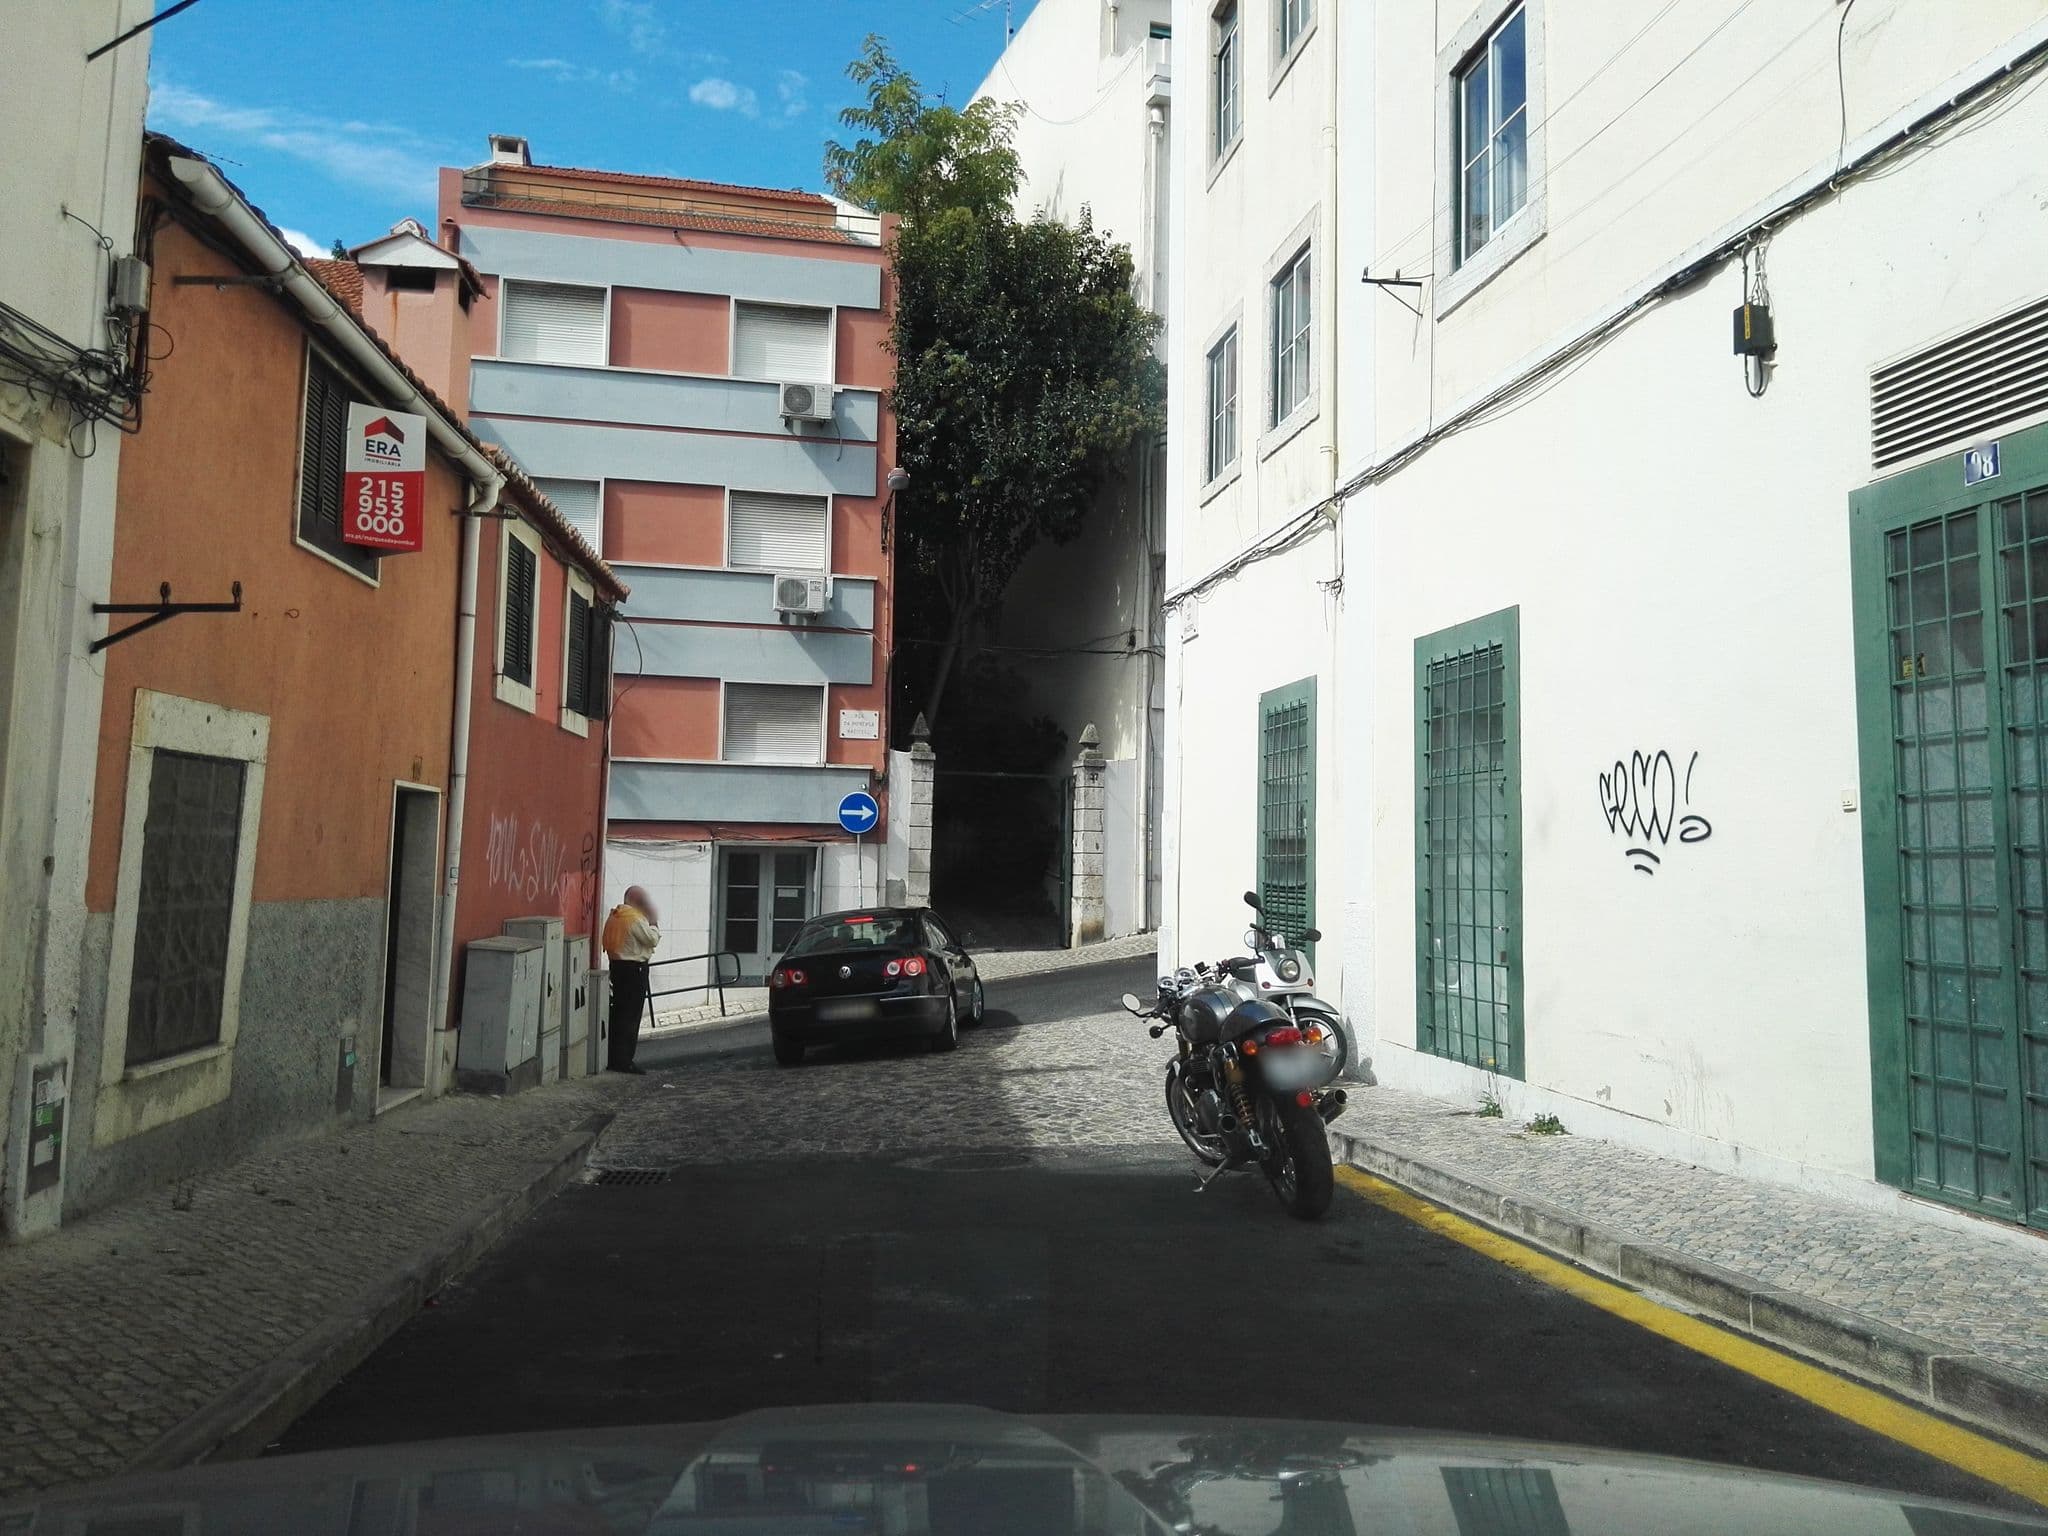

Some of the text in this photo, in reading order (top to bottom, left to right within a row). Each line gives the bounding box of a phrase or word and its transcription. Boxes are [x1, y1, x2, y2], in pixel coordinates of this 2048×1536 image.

[366, 439, 401, 457] ERA
[360, 477, 404, 499] 215
[359, 495, 403, 517] 953
[357, 513, 404, 535] 000
